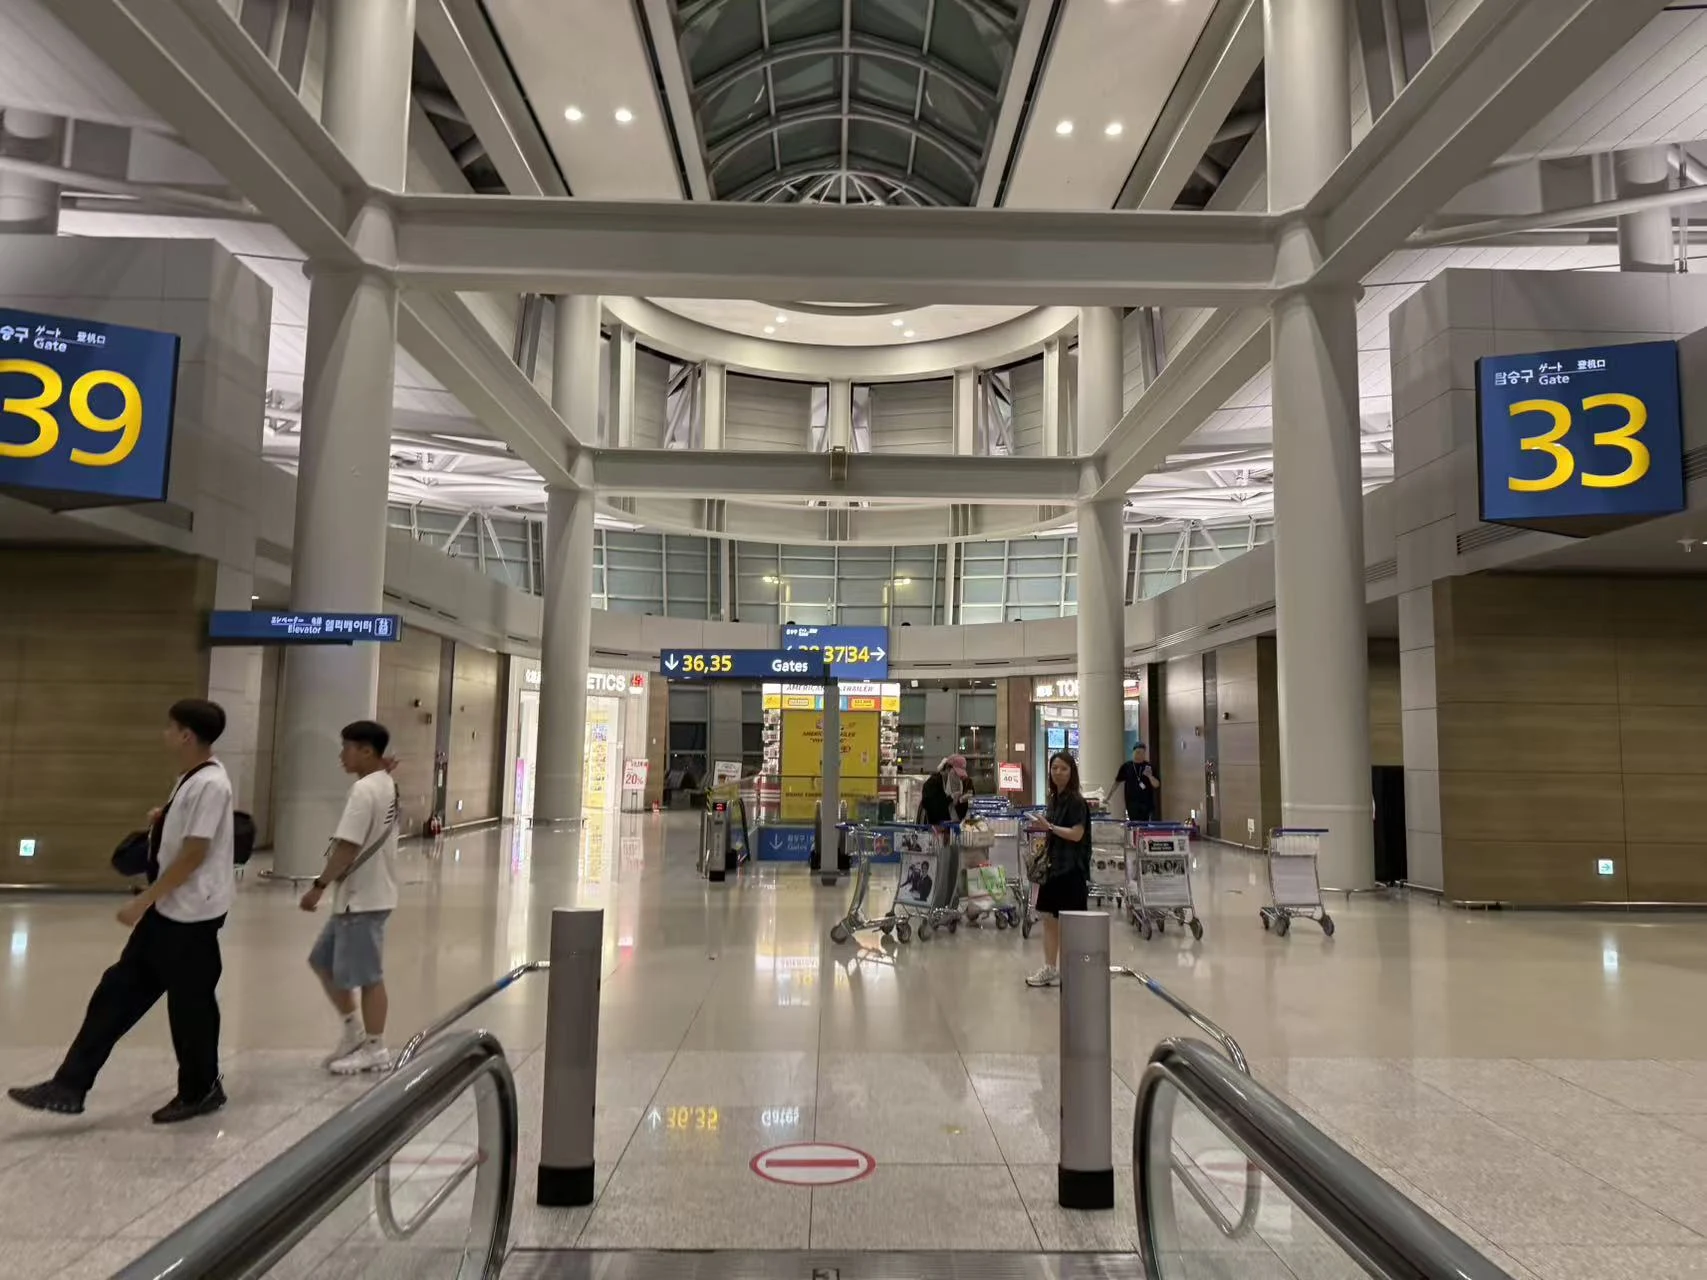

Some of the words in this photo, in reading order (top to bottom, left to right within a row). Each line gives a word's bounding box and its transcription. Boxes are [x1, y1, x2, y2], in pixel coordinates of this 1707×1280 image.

[34, 337, 67, 352] Gate
[1495, 369, 1534, 386] 탑승구
[1538, 374, 1570, 386] Gate
[0, 359, 143, 467] 39
[1508, 392, 1650, 492] 33
[287, 624, 321, 634] Elevator
[682, 654, 732, 674] 36,35
[771, 659, 808, 673] Gates
